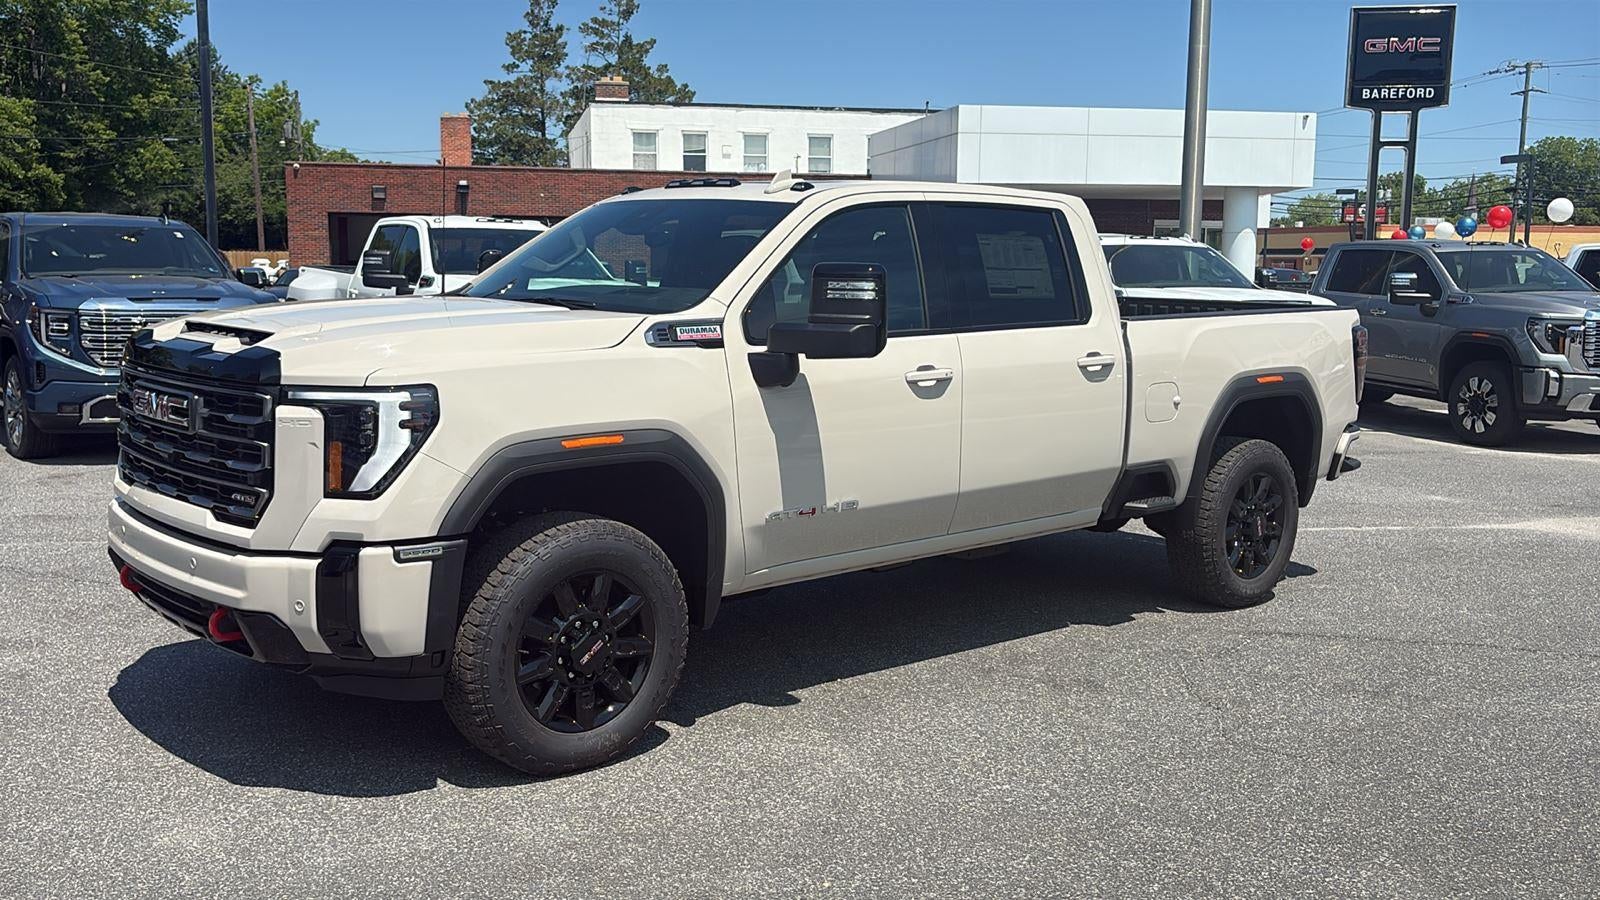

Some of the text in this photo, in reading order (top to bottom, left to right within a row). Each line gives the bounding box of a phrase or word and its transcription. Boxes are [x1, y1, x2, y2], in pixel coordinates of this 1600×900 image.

[1364, 37, 1441, 53] GMC
[1362, 88, 1435, 99] BAREFORD
[679, 326, 718, 334] DURAMAX
[133, 389, 190, 427] GMC
